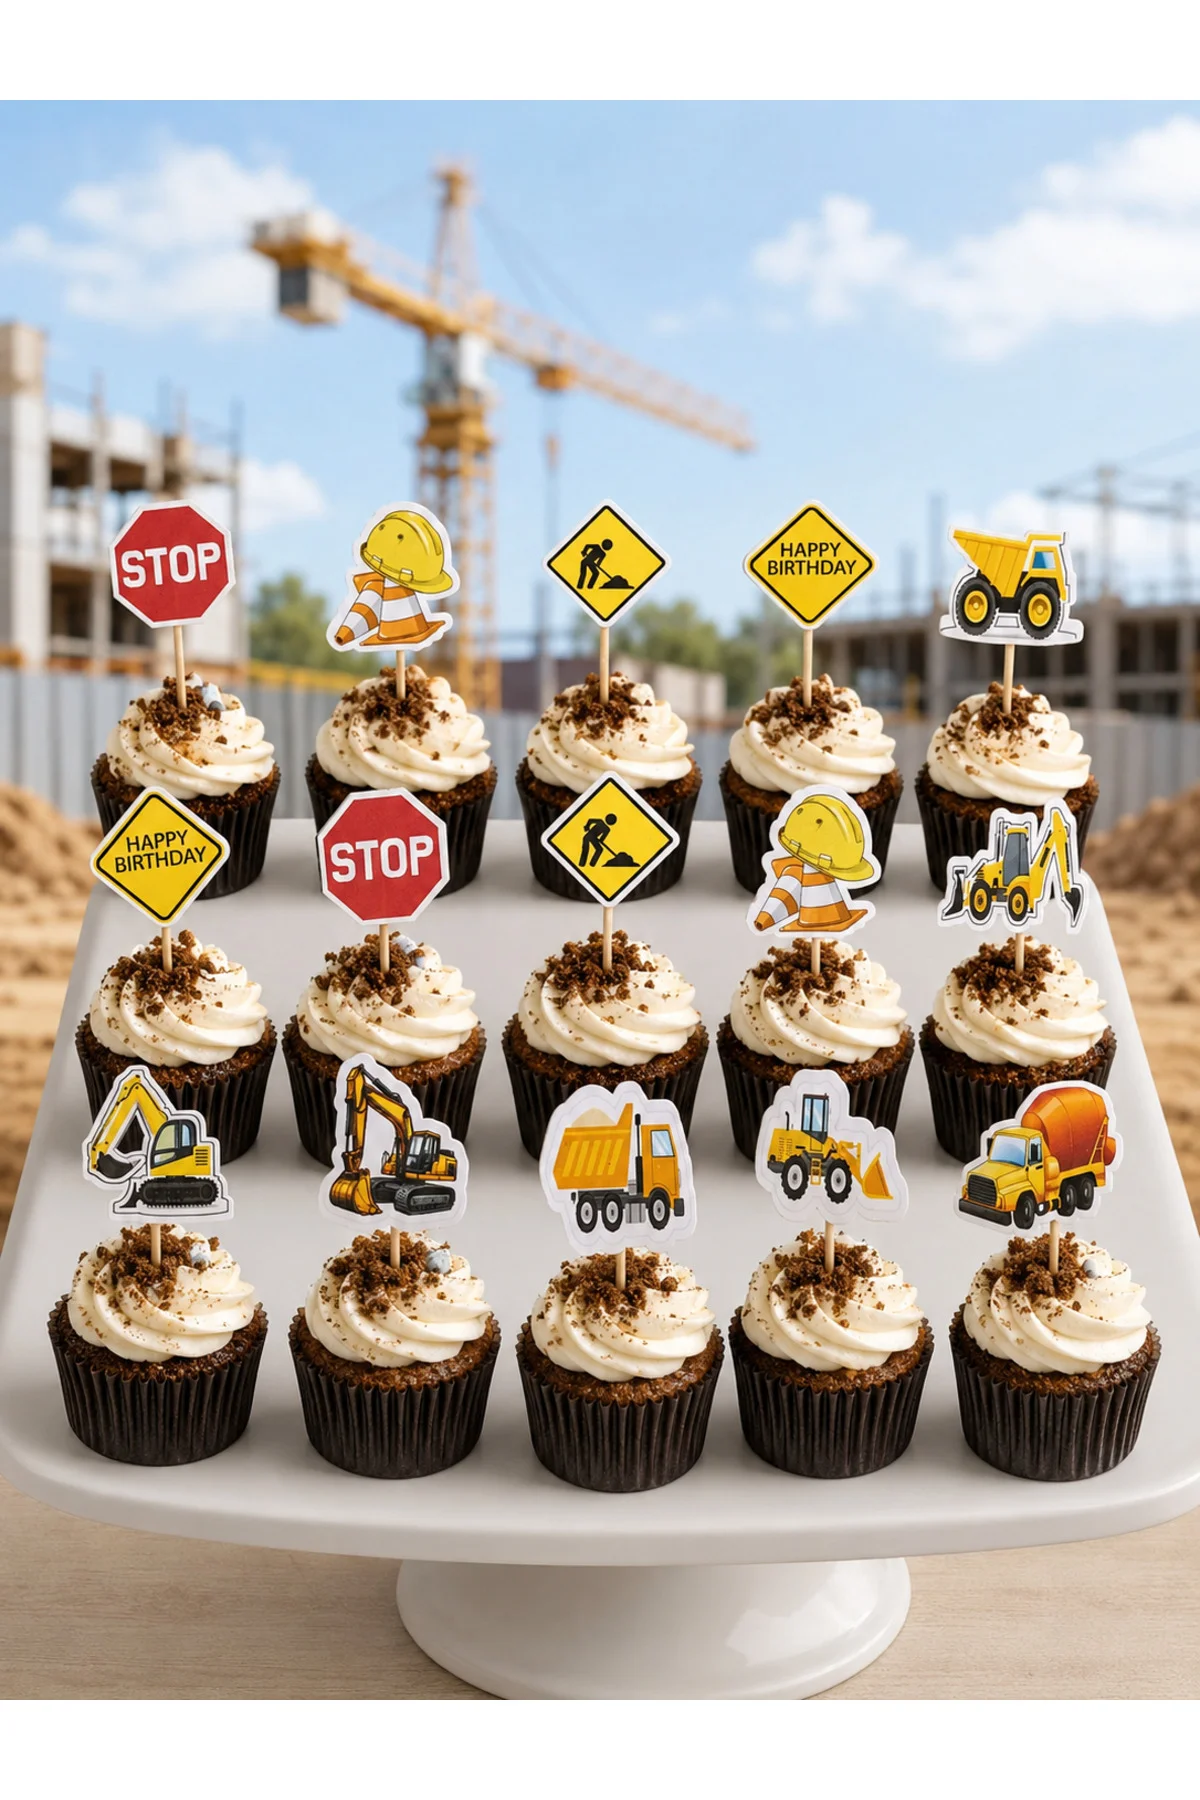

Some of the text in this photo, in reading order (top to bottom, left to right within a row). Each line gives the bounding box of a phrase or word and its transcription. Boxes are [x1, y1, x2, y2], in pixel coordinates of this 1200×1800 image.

[780, 542, 841, 558] HAPPY
[121, 541, 221, 588] STOP
[767, 560, 857, 576] BIRTHDAY
[126, 829, 188, 852] HAPPY
[115, 846, 207, 873] BIRTHDAY
[331, 835, 433, 882] STOP
